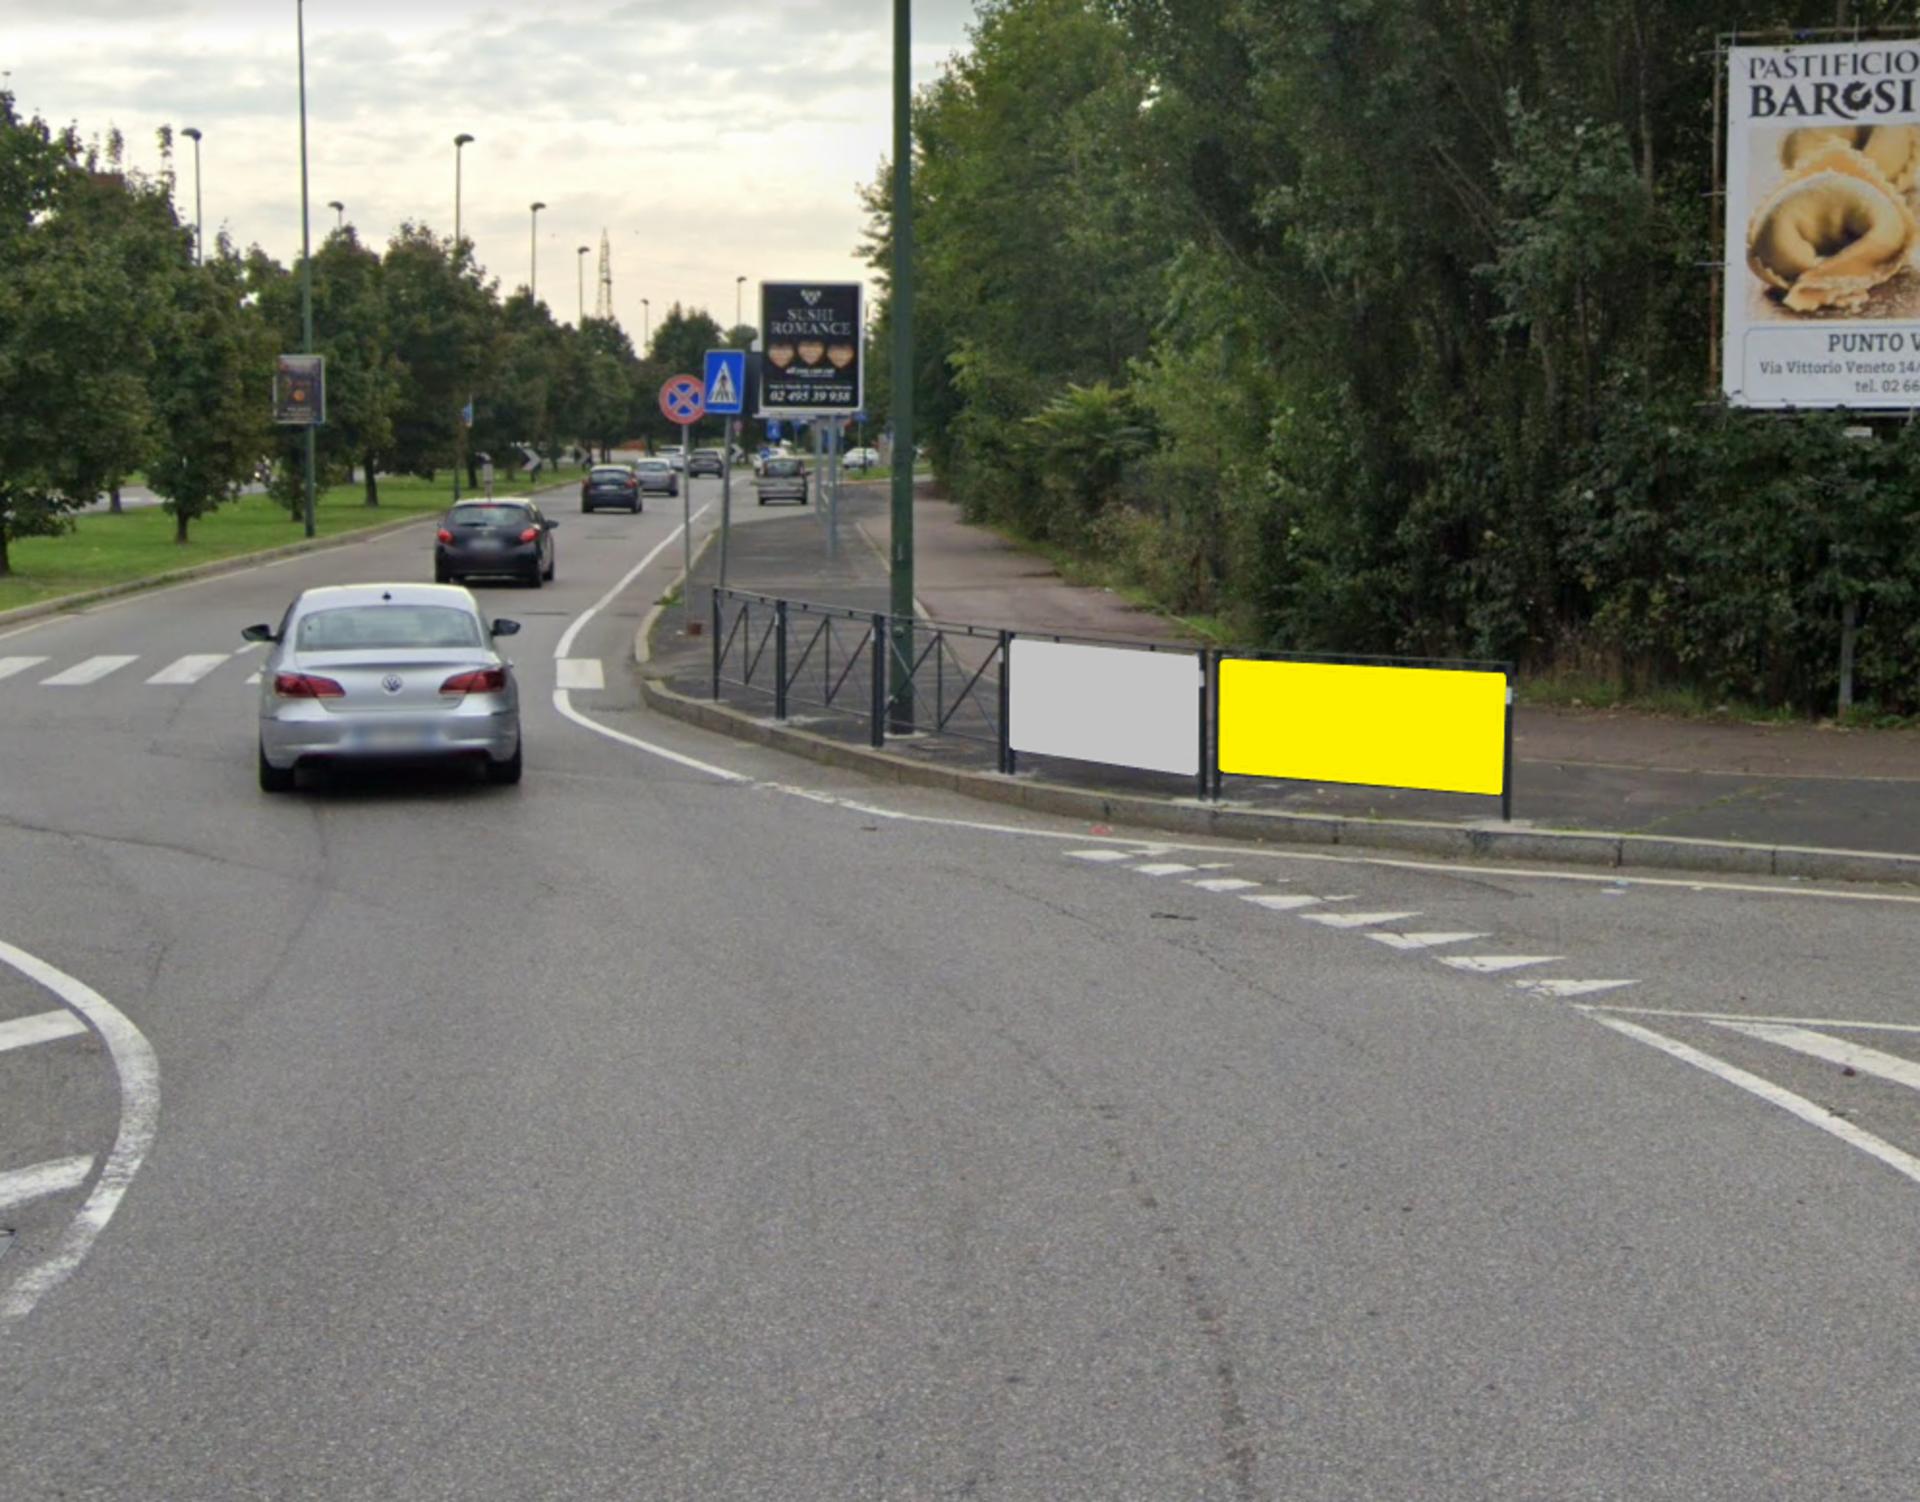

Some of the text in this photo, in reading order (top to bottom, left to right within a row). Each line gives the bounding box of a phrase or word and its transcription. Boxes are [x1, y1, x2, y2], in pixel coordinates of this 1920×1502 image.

[1750, 51, 1919, 79] PASTIFICIO
[1749, 79, 1916, 120] BAROSI
[787, 308, 834, 320] SUSHI
[770, 322, 851, 335] ROMANCE
[1828, 333, 1904, 352] PUNTO
[1760, 361, 1782, 374] Via
[1786, 359, 1842, 374] Vittorio
[1846, 361, 1895, 374] Veneto
[1855, 380, 1877, 393] tel.
[1882, 380, 1900, 393] 02
[769, 391, 785, 401] 02
